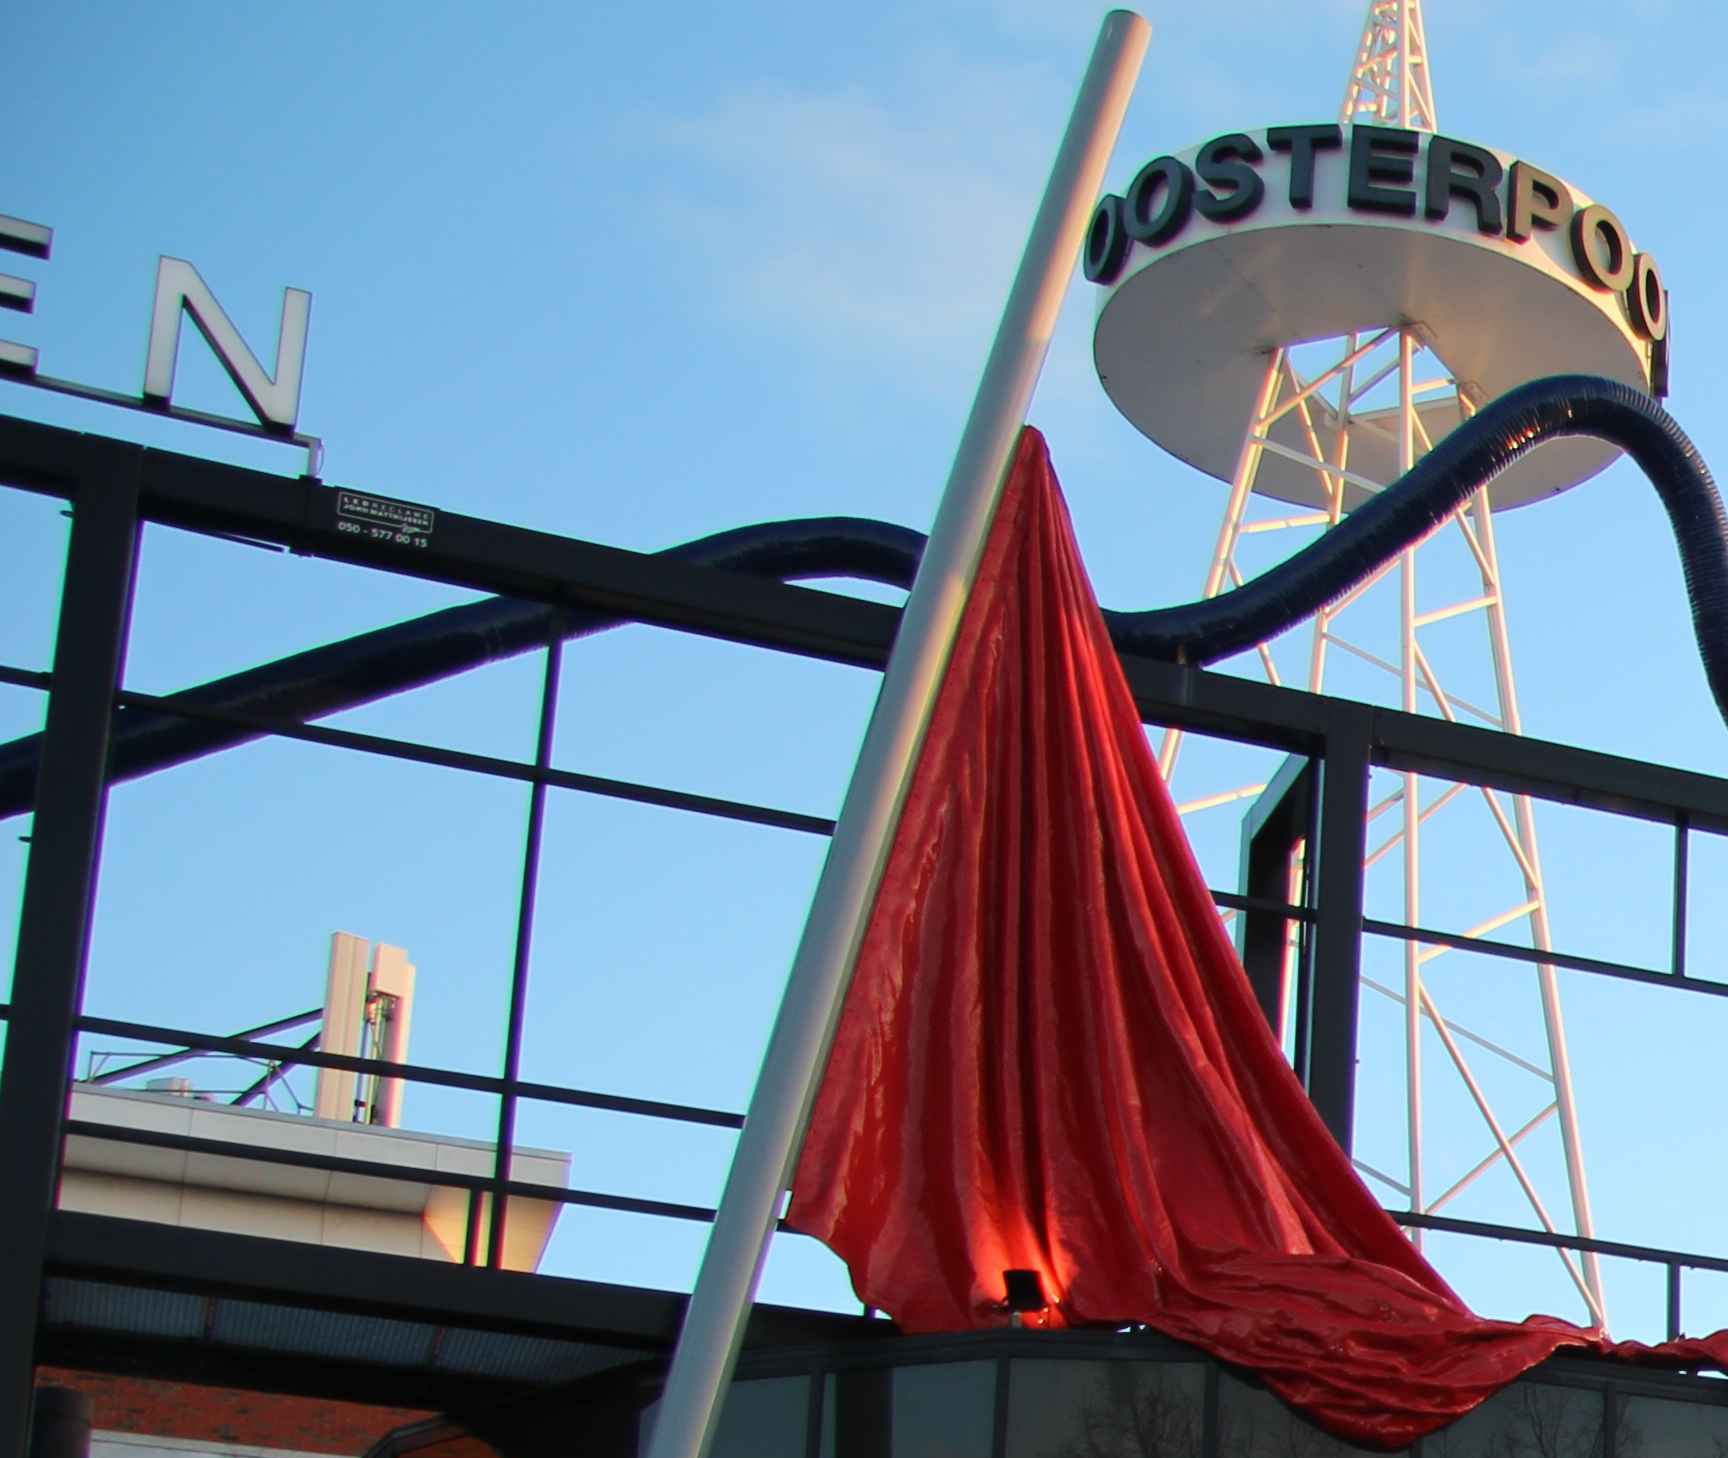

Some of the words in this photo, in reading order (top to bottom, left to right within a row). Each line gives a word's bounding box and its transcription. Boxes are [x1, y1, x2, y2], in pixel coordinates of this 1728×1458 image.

[1083, 124, 1668, 398] OOSTERPOO
[337, 521, 361, 534] 050
[370, 528, 394, 541] 577
